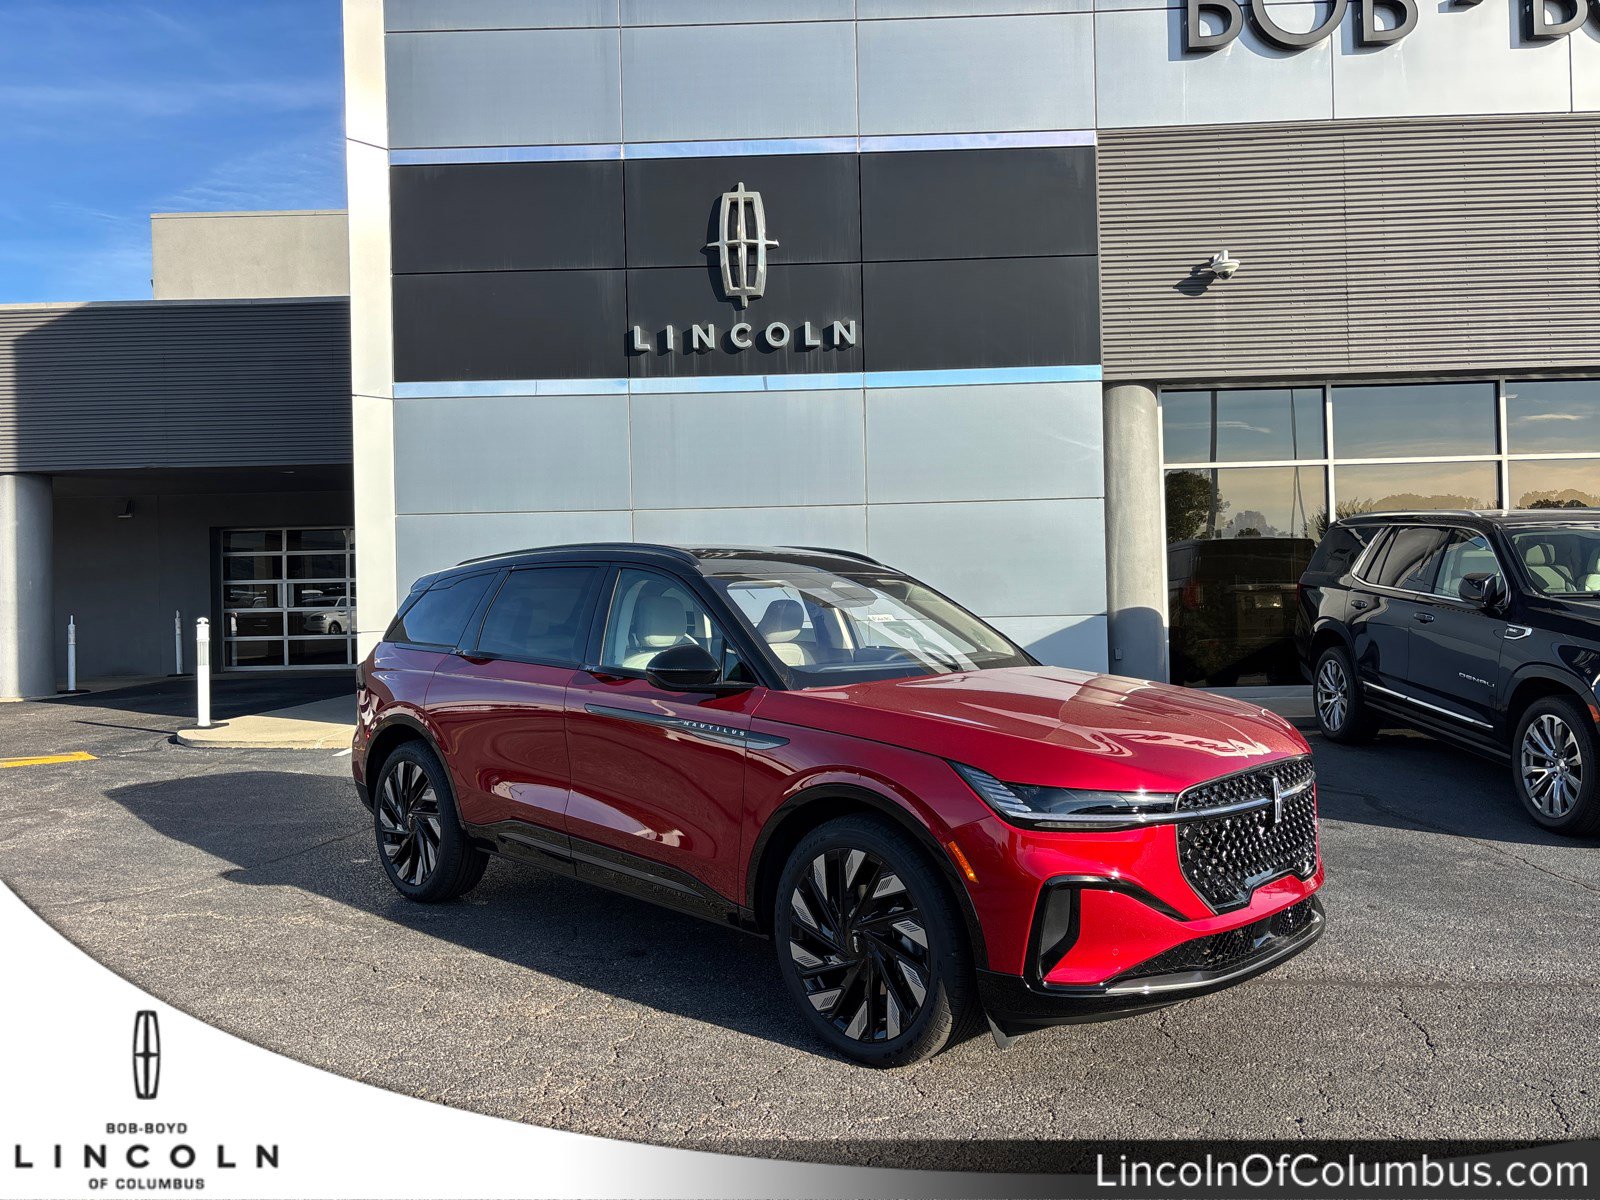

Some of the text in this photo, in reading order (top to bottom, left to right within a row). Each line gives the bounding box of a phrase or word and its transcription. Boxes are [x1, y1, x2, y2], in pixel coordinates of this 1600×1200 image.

[633, 320, 856, 351] LINCOLN
[1458, 672, 1495, 688] DENALI
[683, 720, 746, 737] NAUTILUS
